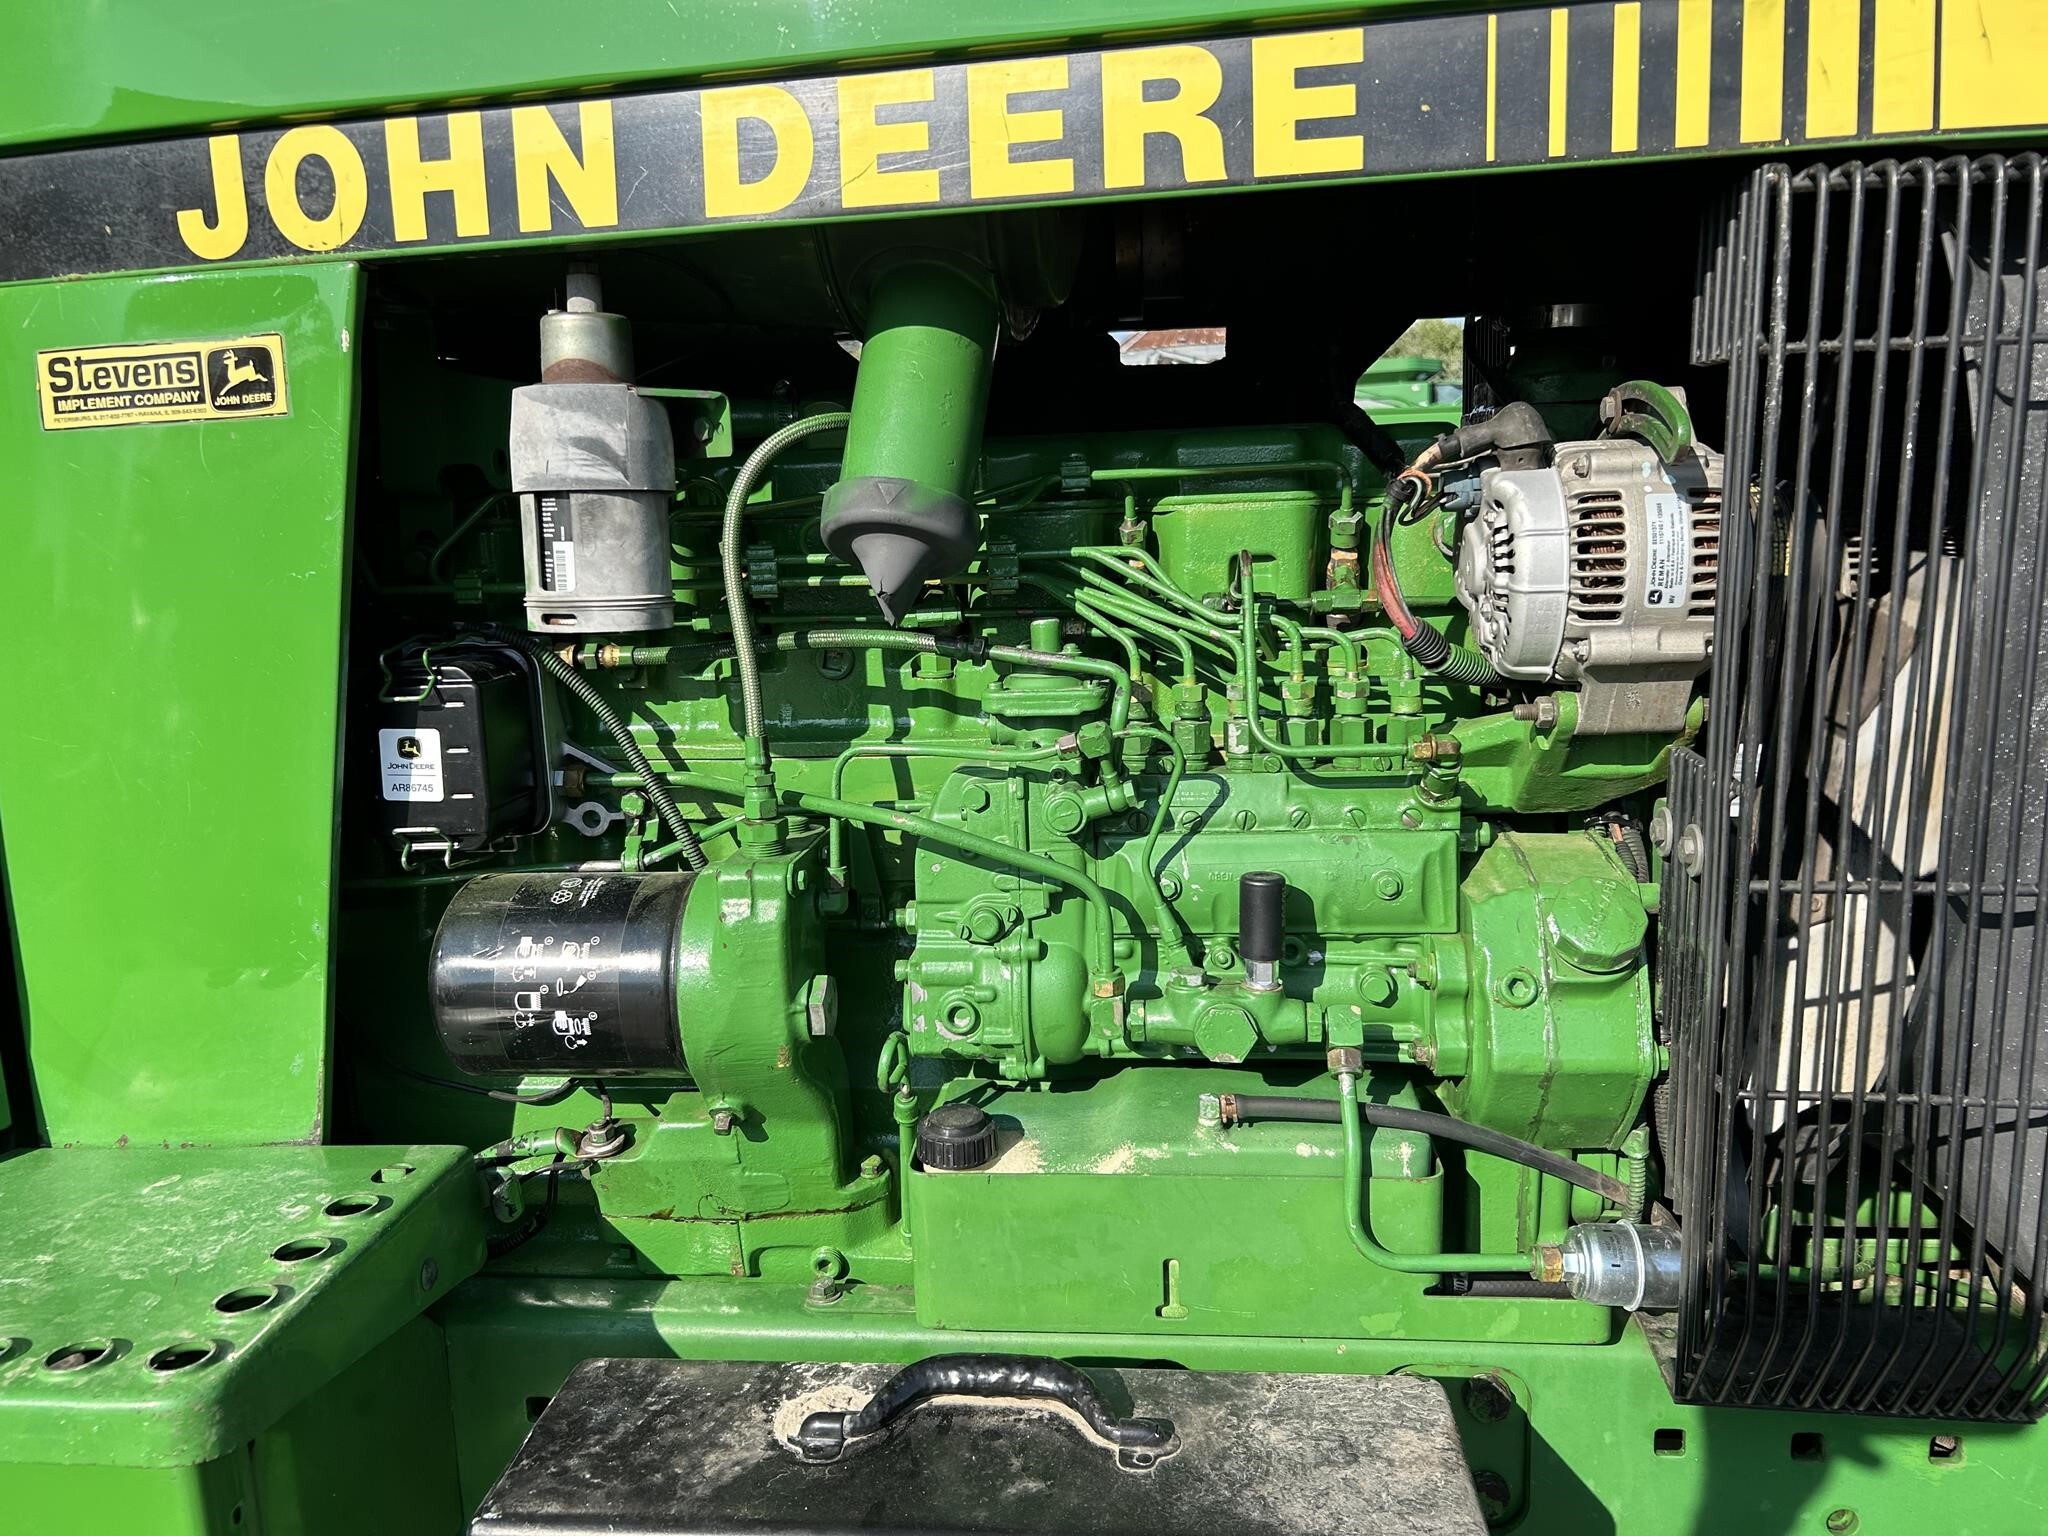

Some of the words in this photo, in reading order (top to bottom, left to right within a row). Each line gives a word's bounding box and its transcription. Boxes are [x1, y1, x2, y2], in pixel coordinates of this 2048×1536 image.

[177, 100, 619, 260] JOHN
[701, 27, 1365, 218] DEERE
[48, 356, 196, 393] Stevens
[58, 394, 132, 412] IMPLEMENT
[134, 391, 200, 407] COMPANY
[214, 394, 240, 406] JOHN
[242, 392, 273, 404] DEERE
[391, 783, 434, 792] AR86745
